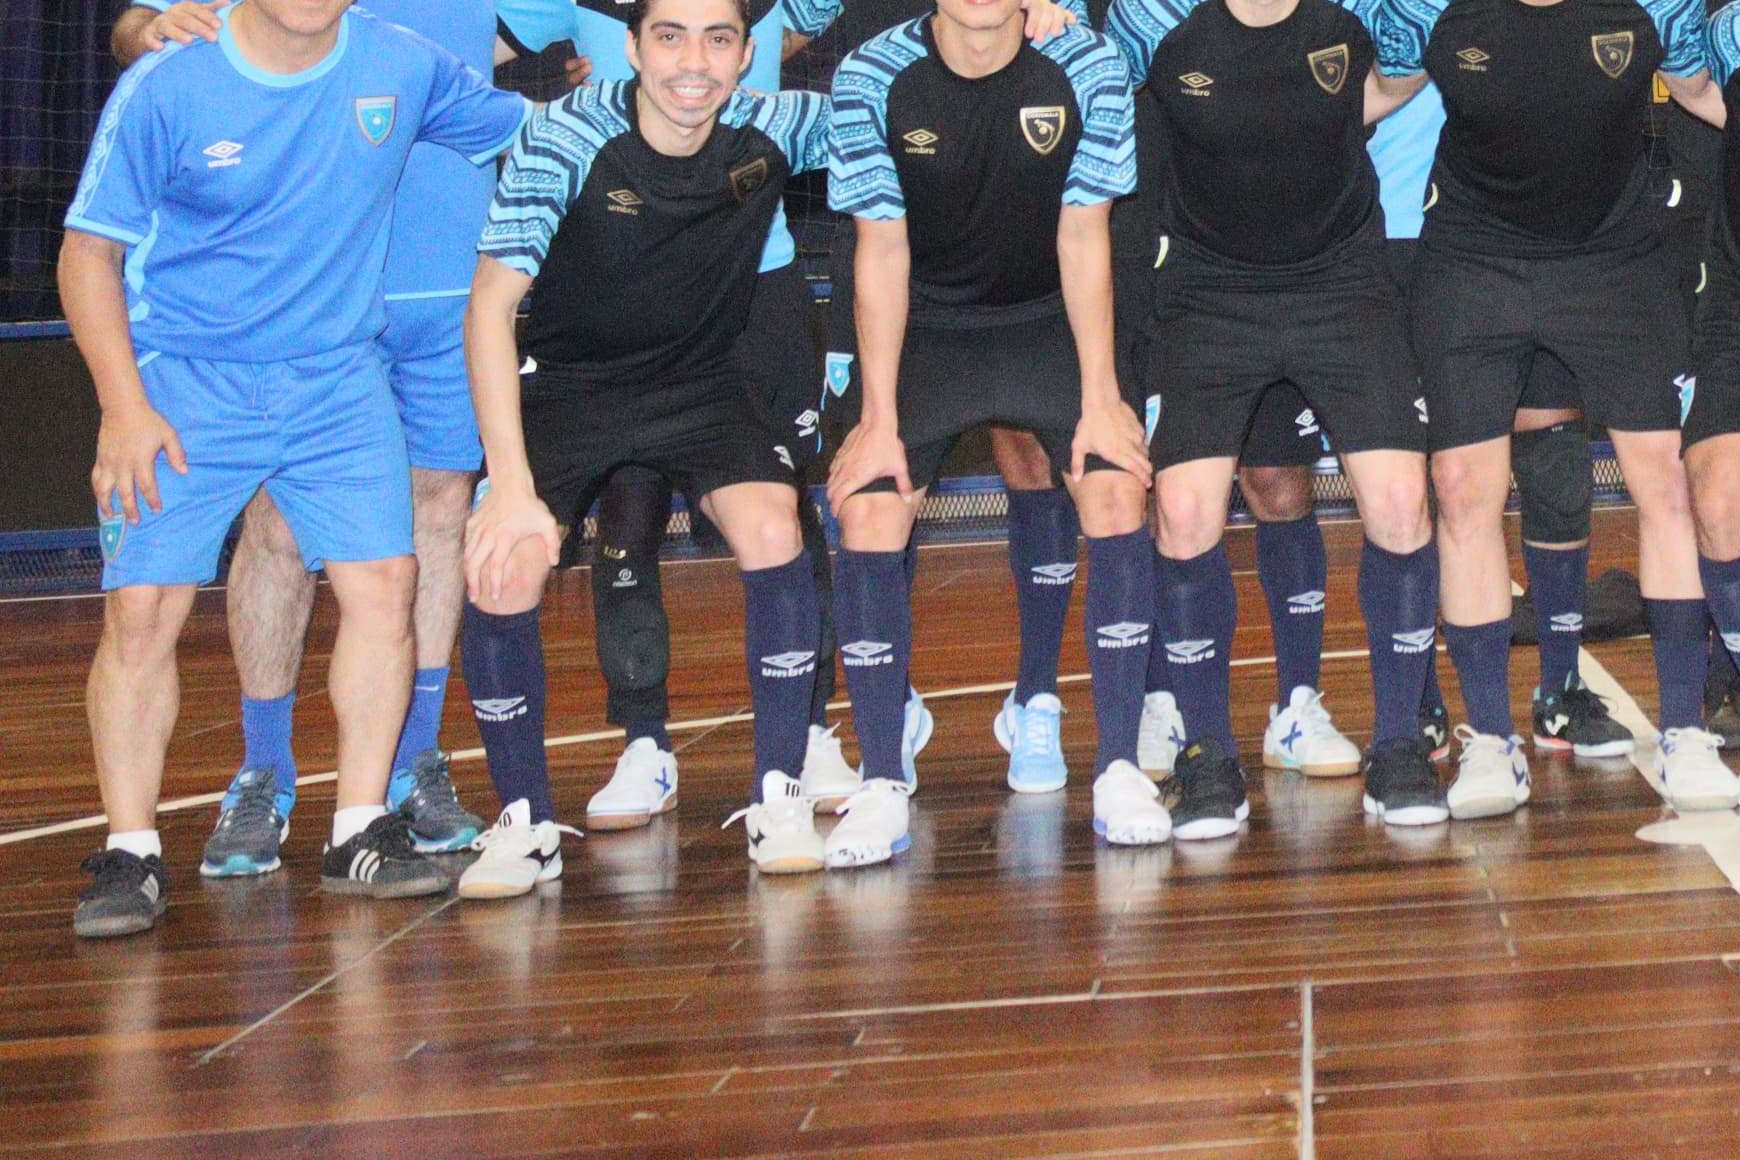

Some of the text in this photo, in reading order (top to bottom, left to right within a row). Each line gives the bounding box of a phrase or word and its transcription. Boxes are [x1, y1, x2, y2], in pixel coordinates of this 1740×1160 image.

[607, 204, 639, 216] umbro
[1097, 635, 1149, 648] umbro
[844, 654, 893, 666] umbro
[1168, 649, 1215, 664] umbro
[762, 662, 815, 678] umbro
[475, 705, 528, 722] umbro
